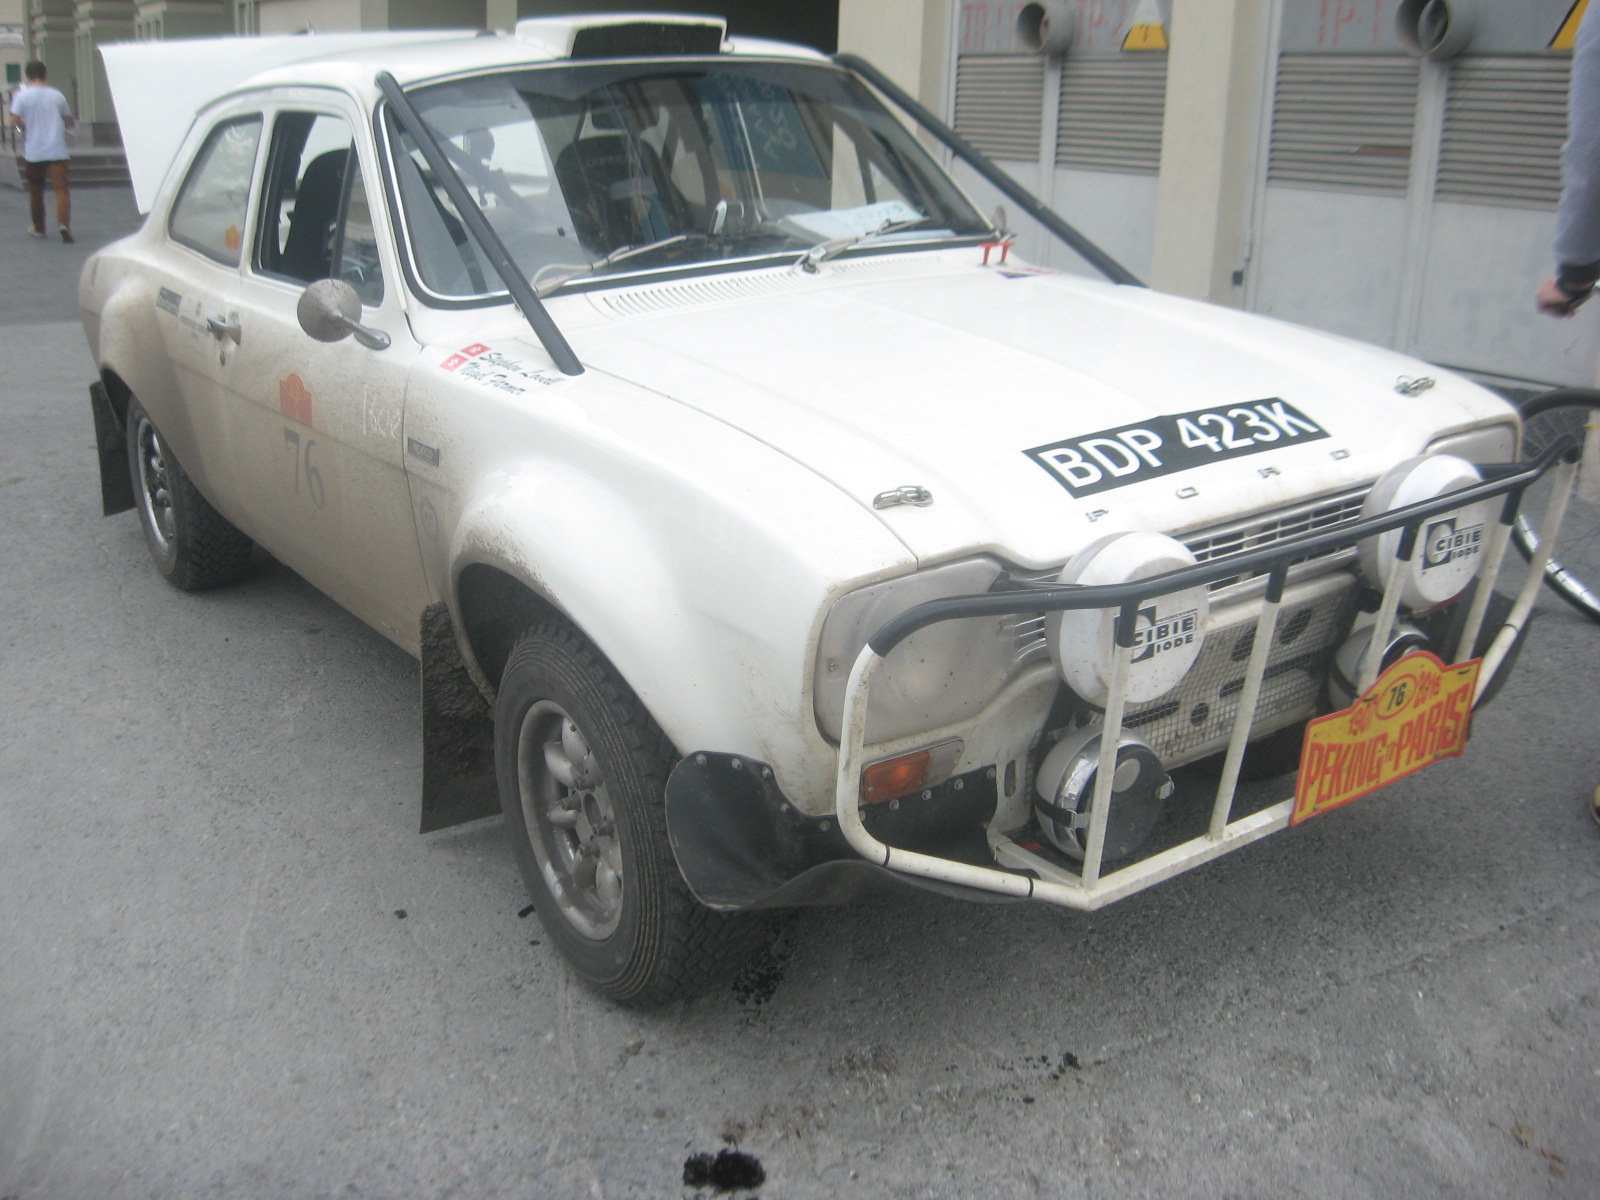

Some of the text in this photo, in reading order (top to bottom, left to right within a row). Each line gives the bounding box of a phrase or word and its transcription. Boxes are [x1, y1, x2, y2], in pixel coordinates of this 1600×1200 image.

[283, 426, 325, 510] 76
[1037, 401, 1320, 488] BDP 423K
[1085, 448, 1351, 523] FORD
[1436, 529, 1482, 552] CIBIE
[1452, 544, 1480, 560] IODE
[1156, 633, 1194, 654] IODE
[1387, 682, 1408, 712] 76
[1298, 731, 1389, 813] PEKING
[1392, 682, 1471, 772] PARIS
